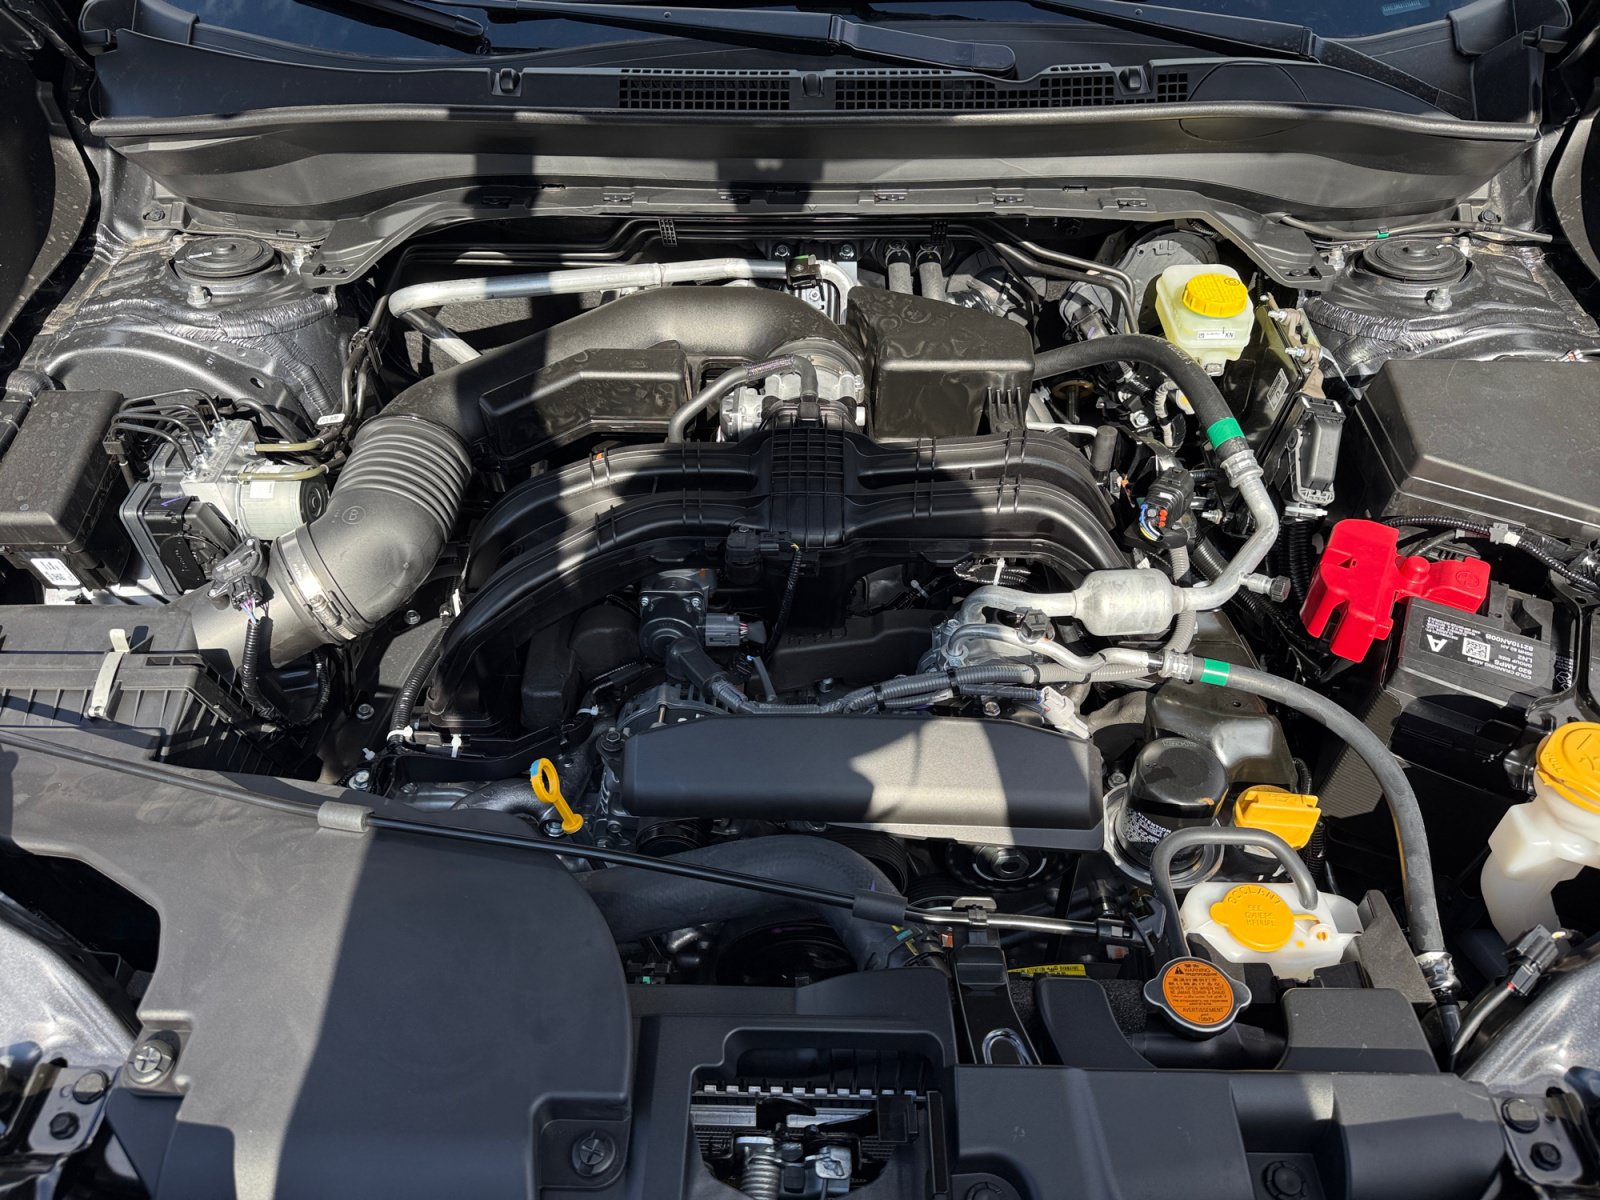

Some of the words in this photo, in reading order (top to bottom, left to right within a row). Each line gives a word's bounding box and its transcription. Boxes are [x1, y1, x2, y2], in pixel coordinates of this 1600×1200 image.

[1426, 633, 1448, 653] A
[1494, 659, 1517, 671] AMPS
[1518, 666, 1532, 675] 620
[1515, 671, 1532, 680] COLD
[1228, 886, 1281, 904] COOLANT
